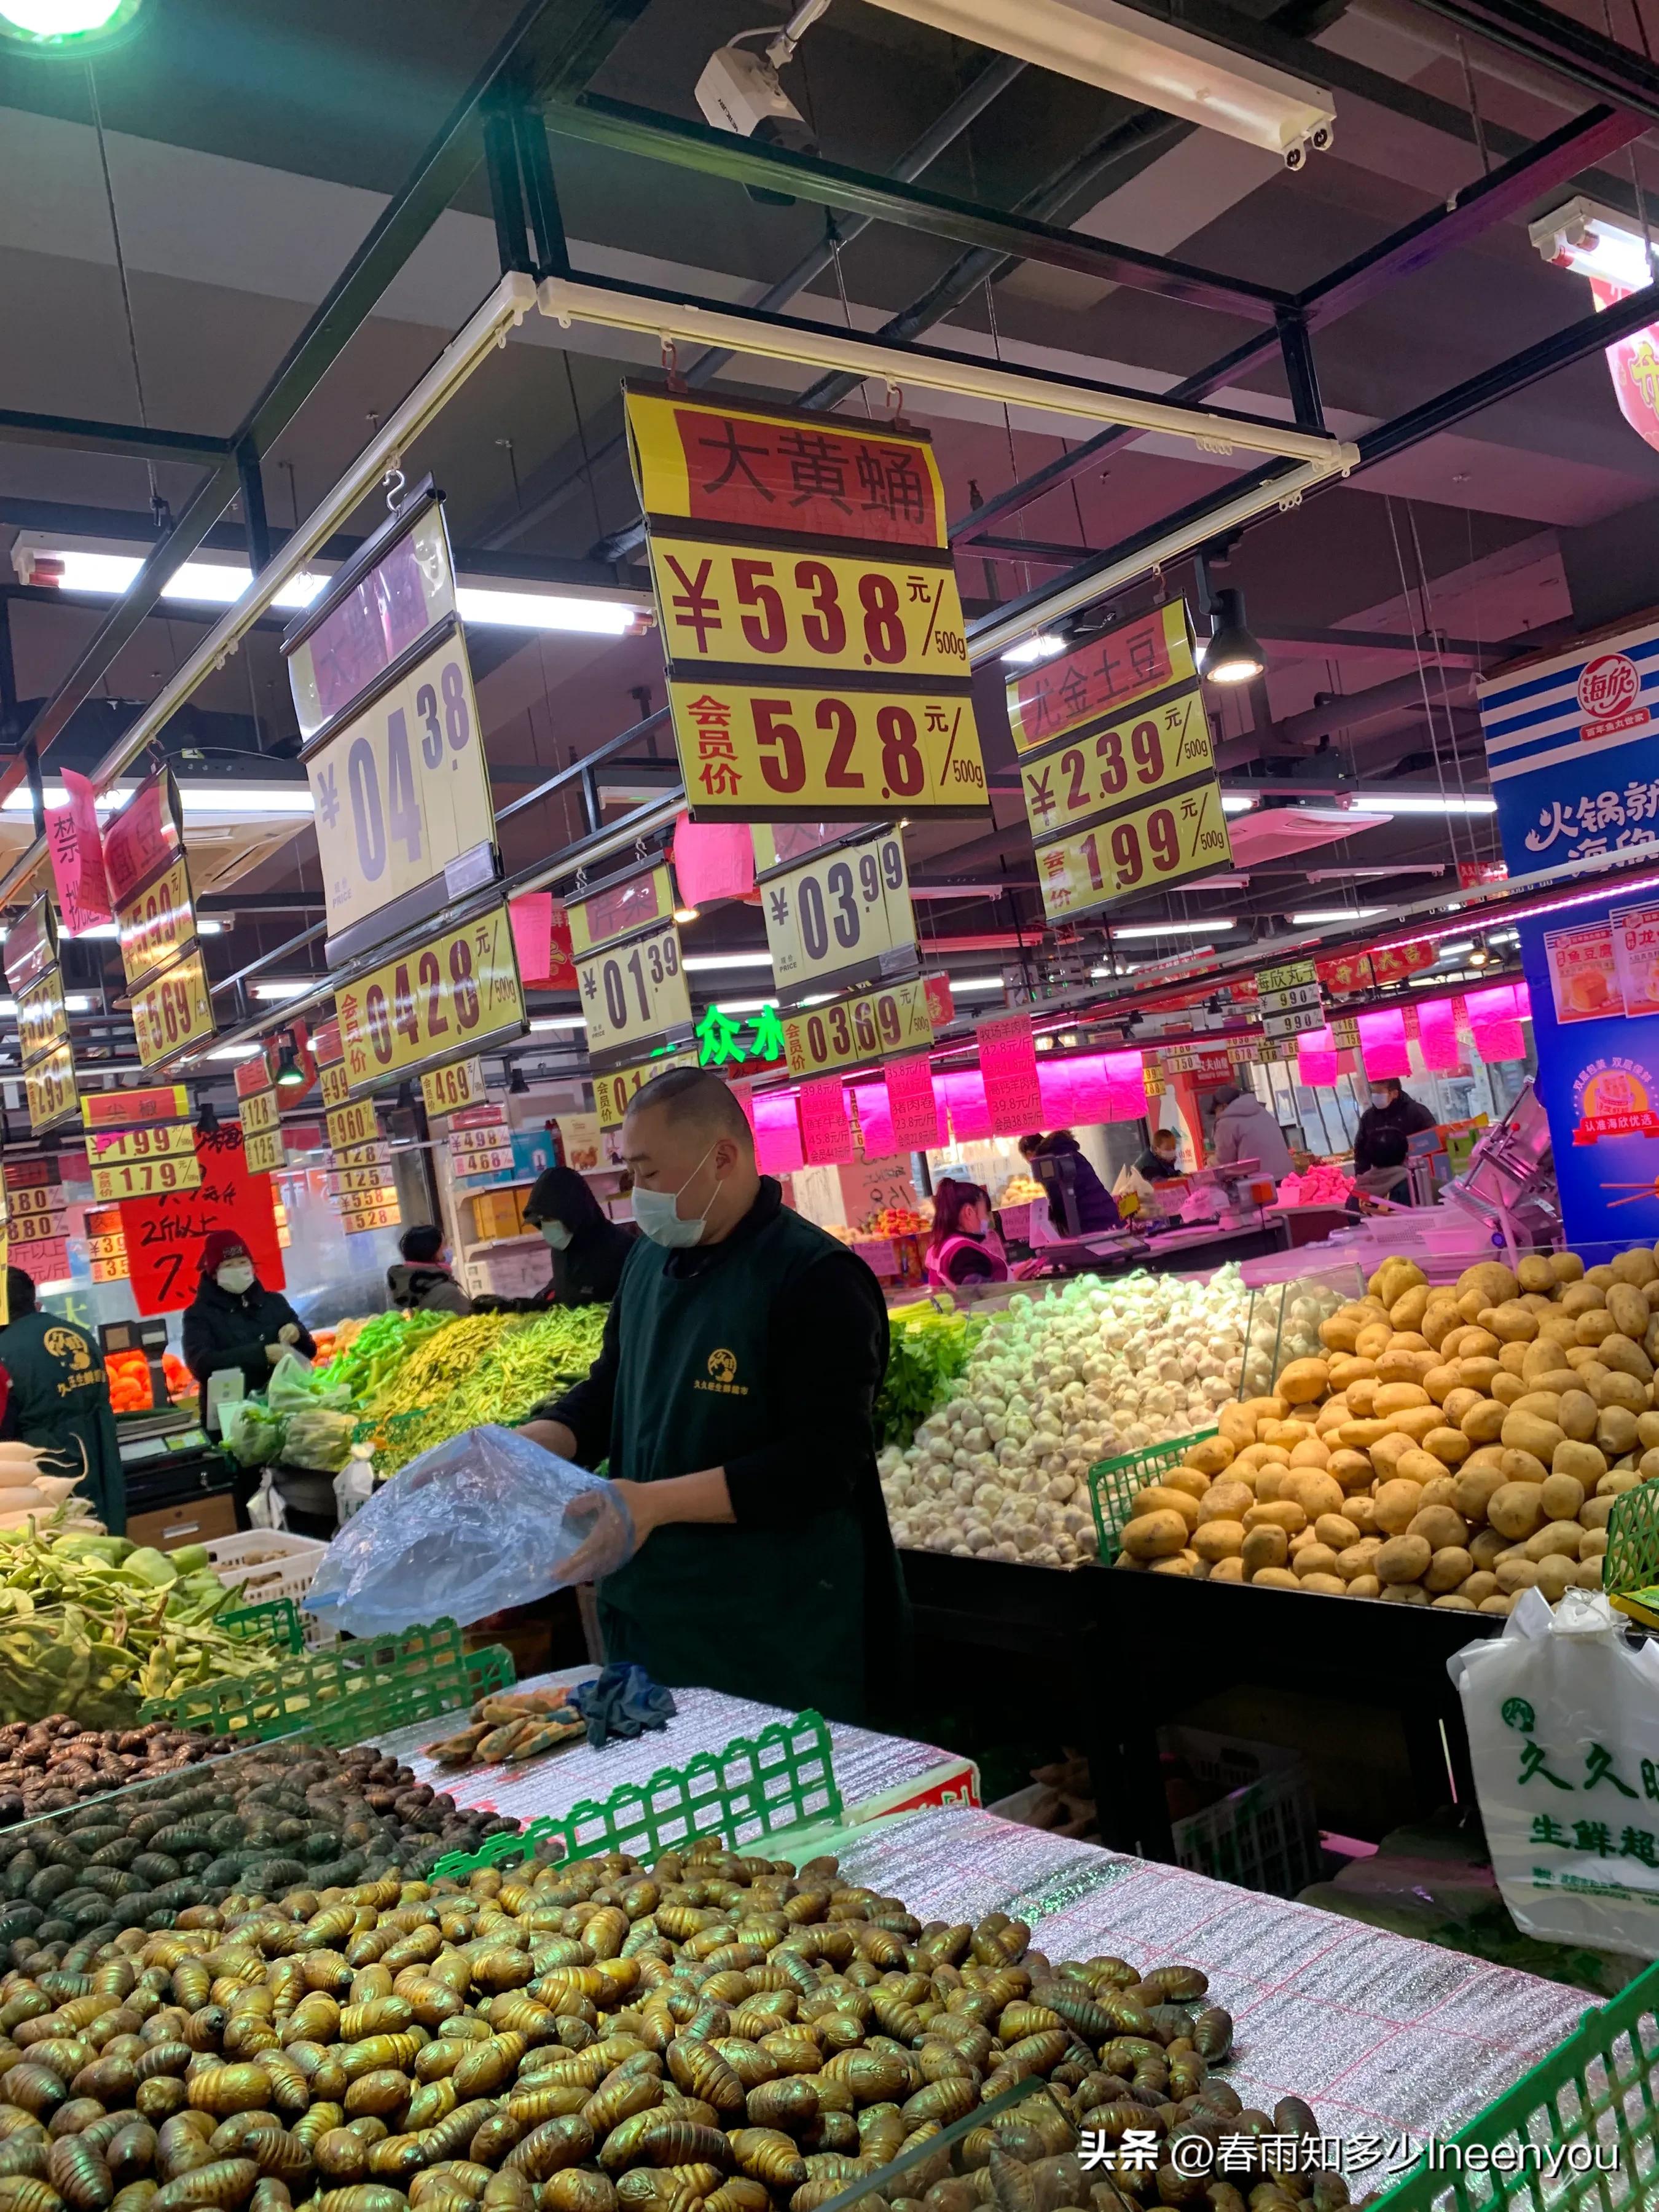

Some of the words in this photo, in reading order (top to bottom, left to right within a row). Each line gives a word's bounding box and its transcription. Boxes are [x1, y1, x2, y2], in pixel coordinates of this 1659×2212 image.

[696, 420, 925, 525] 大黄蛹
[1582, 667, 1635, 708] 海欣
[686, 694, 743, 796] 会员价
[332, 889, 353, 909] PRICE
[779, 962, 798, 973] PRICE
[341, 993, 367, 1075] 会员价
[785, 1023, 806, 1072] 会员价
[597, 1081, 613, 1123] 会员价
[1585, 1113, 1652, 1132] 认准海欣优选
